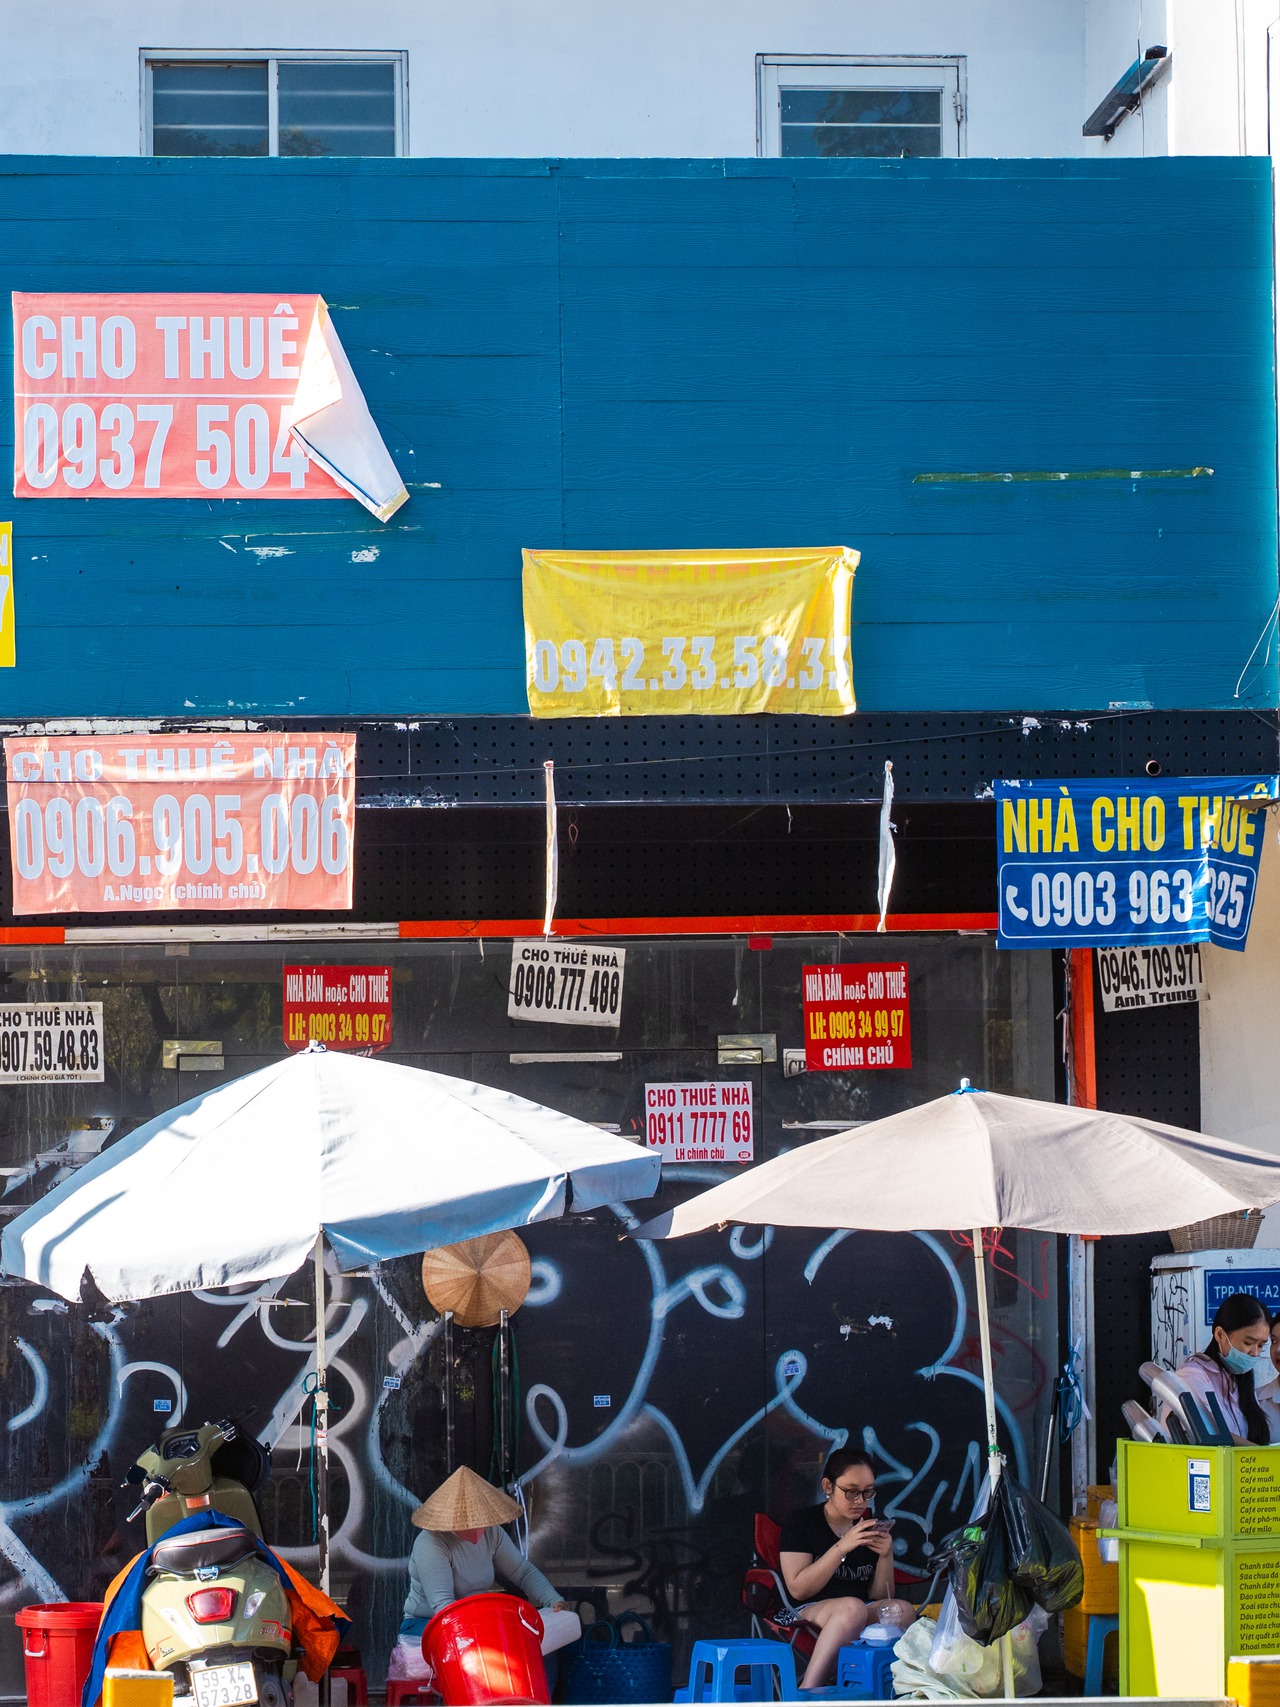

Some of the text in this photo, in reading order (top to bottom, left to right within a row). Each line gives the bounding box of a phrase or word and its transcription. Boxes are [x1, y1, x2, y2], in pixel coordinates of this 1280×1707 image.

[22, 303, 299, 379] CHO THUÊ
[24, 403, 174, 489] 0937
[12, 741, 348, 781] CHO THUÊ NHÀ
[1002, 784, 1271, 856] NHÀ CHO THUÊ
[16, 794, 347, 879] 0906.905.006
[103, 881, 266, 903] A.Ngọc (chính chủ)
[1032, 868, 1247, 928] 0903 963 325
[522, 948, 618, 967] CHO THUÊ NHÀ
[1100, 943, 1202, 994] 0946.709.977
[287, 969, 388, 1005] NHÀ BÁN HOẶC CHO THUÊ
[515, 964, 619, 1014] 0908.777.488
[806, 965, 906, 1003] NHÀ BÁN HOẶC CHO THUÊ
[1115, 989, 1197, 1008] Anh Trung
[26, 1007, 60, 1026] THUÊ
[66, 1006, 95, 1025] NHÀ
[289, 1013, 385, 1041] LH: 0903 34 99 97
[810, 1010, 903, 1039] LH: 0903 34 99 97
[823, 1040, 894, 1066] CHÍNH CHỦ
[648, 1083, 750, 1107] CHO THUÊ NHÀ
[648, 1111, 750, 1145] 0911 7777 69
[676, 1148, 684, 1160] LH
[688, 1147, 708, 1159] chính
[711, 1146, 724, 1159] chủ
[202, 1667, 244, 1688] 59-X4
[201, 1684, 252, 1707] 573.28
